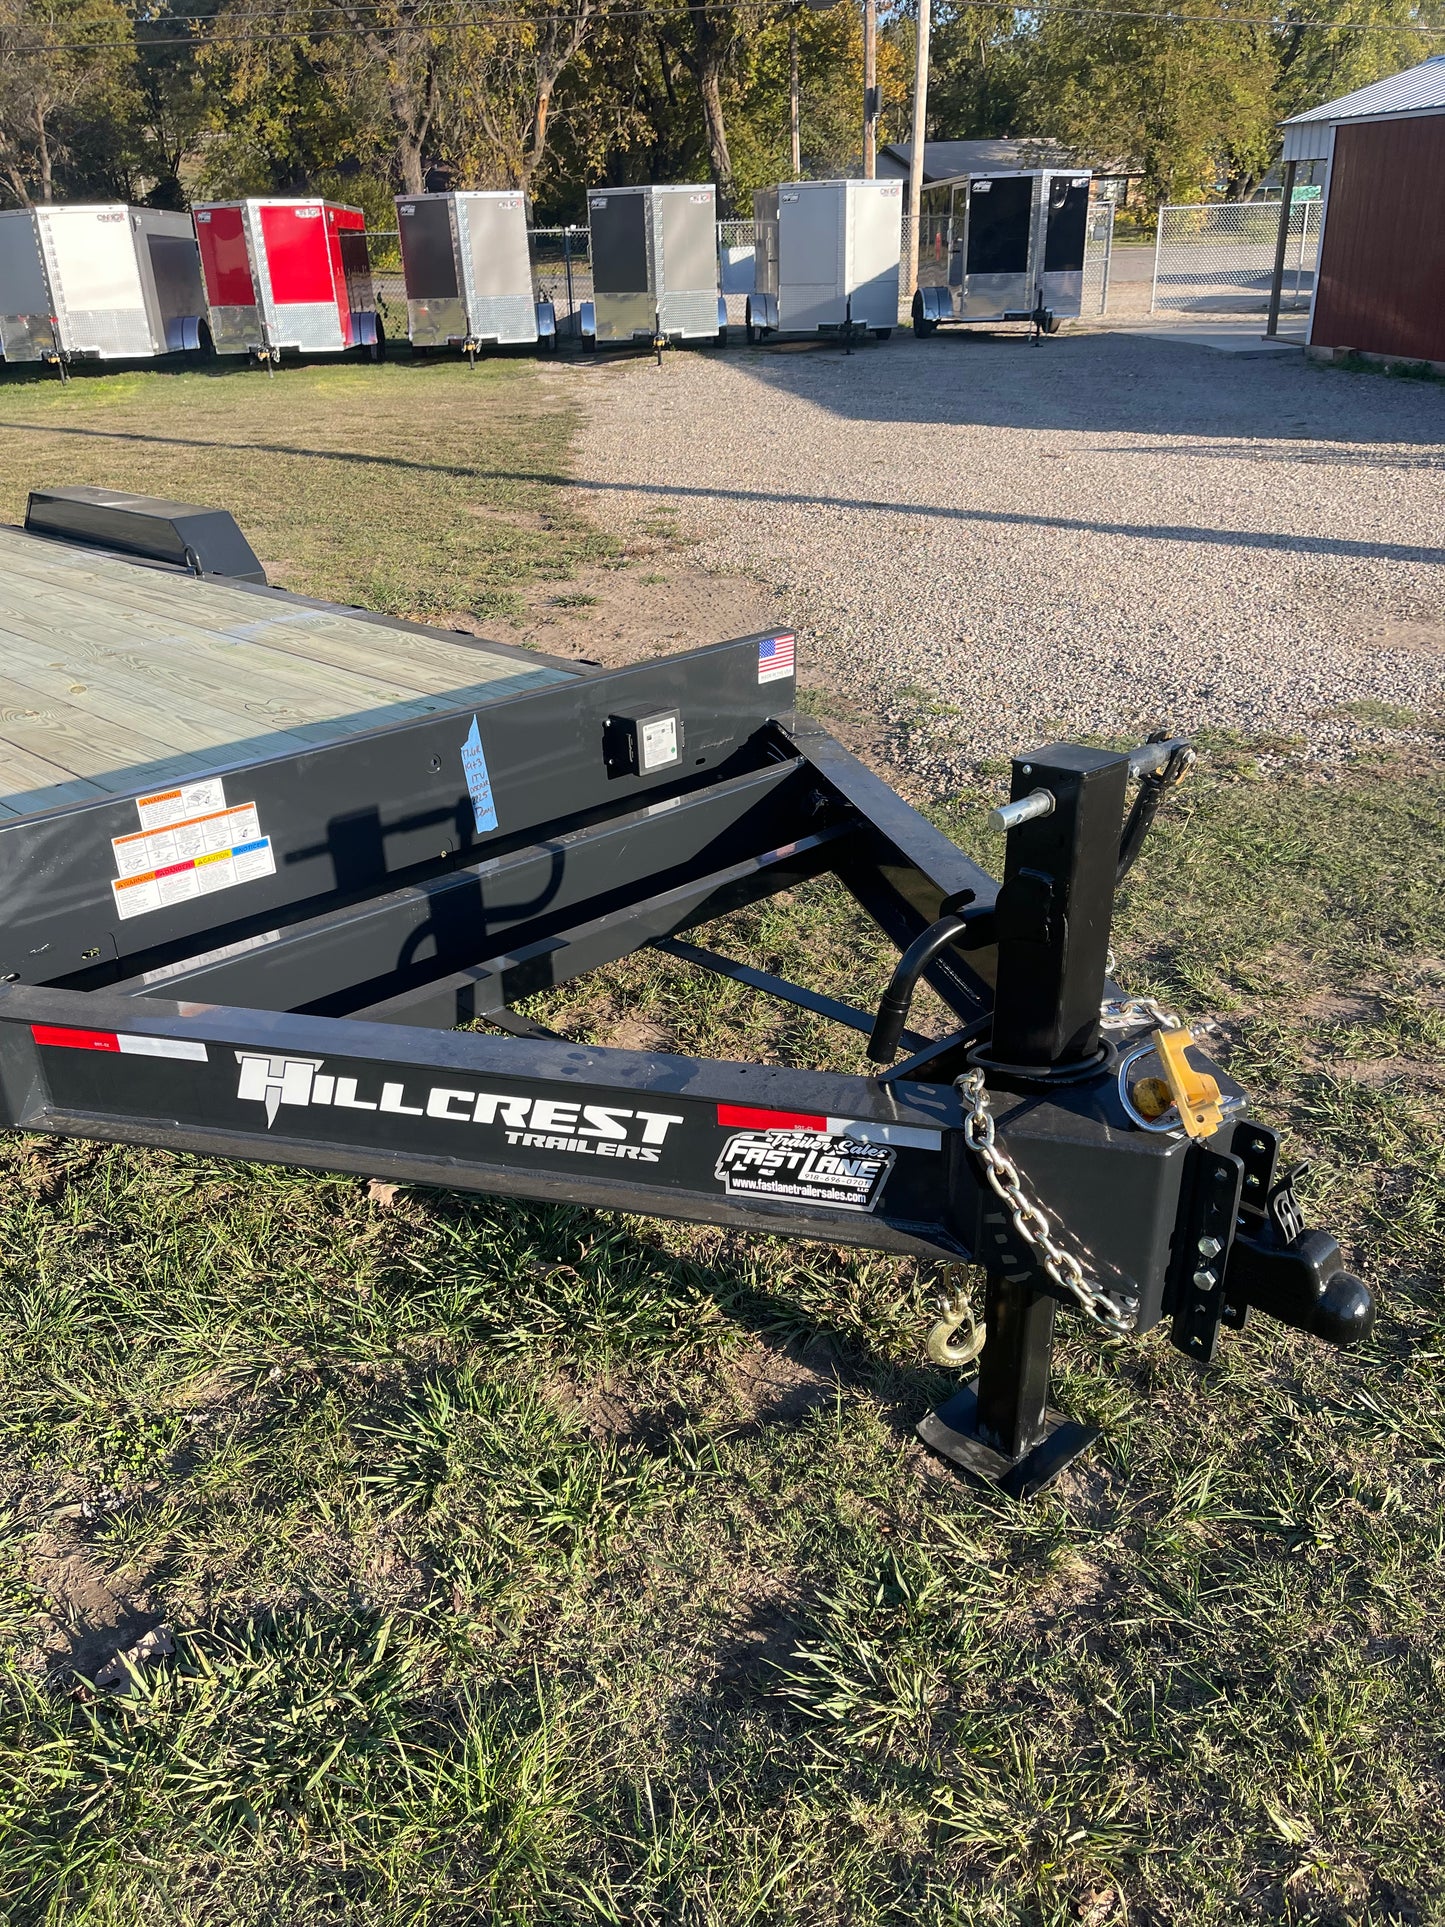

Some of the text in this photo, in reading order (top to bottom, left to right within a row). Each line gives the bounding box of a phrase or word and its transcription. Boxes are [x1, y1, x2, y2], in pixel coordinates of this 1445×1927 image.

[146, 791, 179, 804] WARNING
[239, 842, 261, 853] NOTICE
[203, 851, 230, 864] CAUTION
[164, 863, 192, 876] DANGER
[123, 873, 154, 887] WARNING
[504, 1130, 662, 1163] TRAILERS
[770, 1132, 888, 1159] Trailer Sales
[804, 1173, 870, 1187] 918-696-0701
[732, 1177, 867, 1204] www.fastlanetrailersales.com
